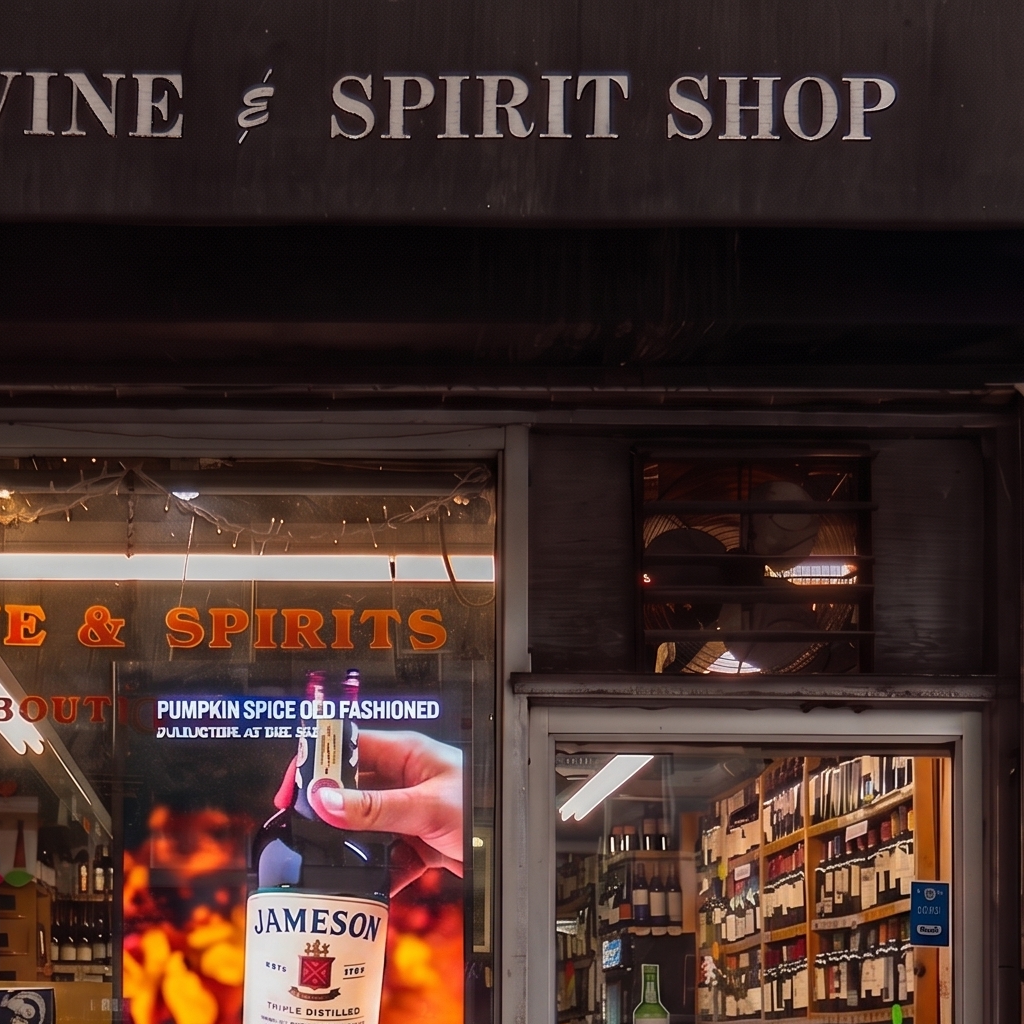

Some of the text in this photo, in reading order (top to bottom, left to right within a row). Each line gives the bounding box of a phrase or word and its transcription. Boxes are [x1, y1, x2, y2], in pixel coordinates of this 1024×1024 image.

[237, 69, 273, 144] &
[330, 74, 629, 140] SPIRIT
[666, 75, 896, 141] SHOP
[77, 605, 125, 648] &
[165, 607, 448, 651] SPIRITS
[157, 700, 440, 720] PUMPKIN SPICE OLD FASHIONED
[254, 908, 382, 942] JAMESON
